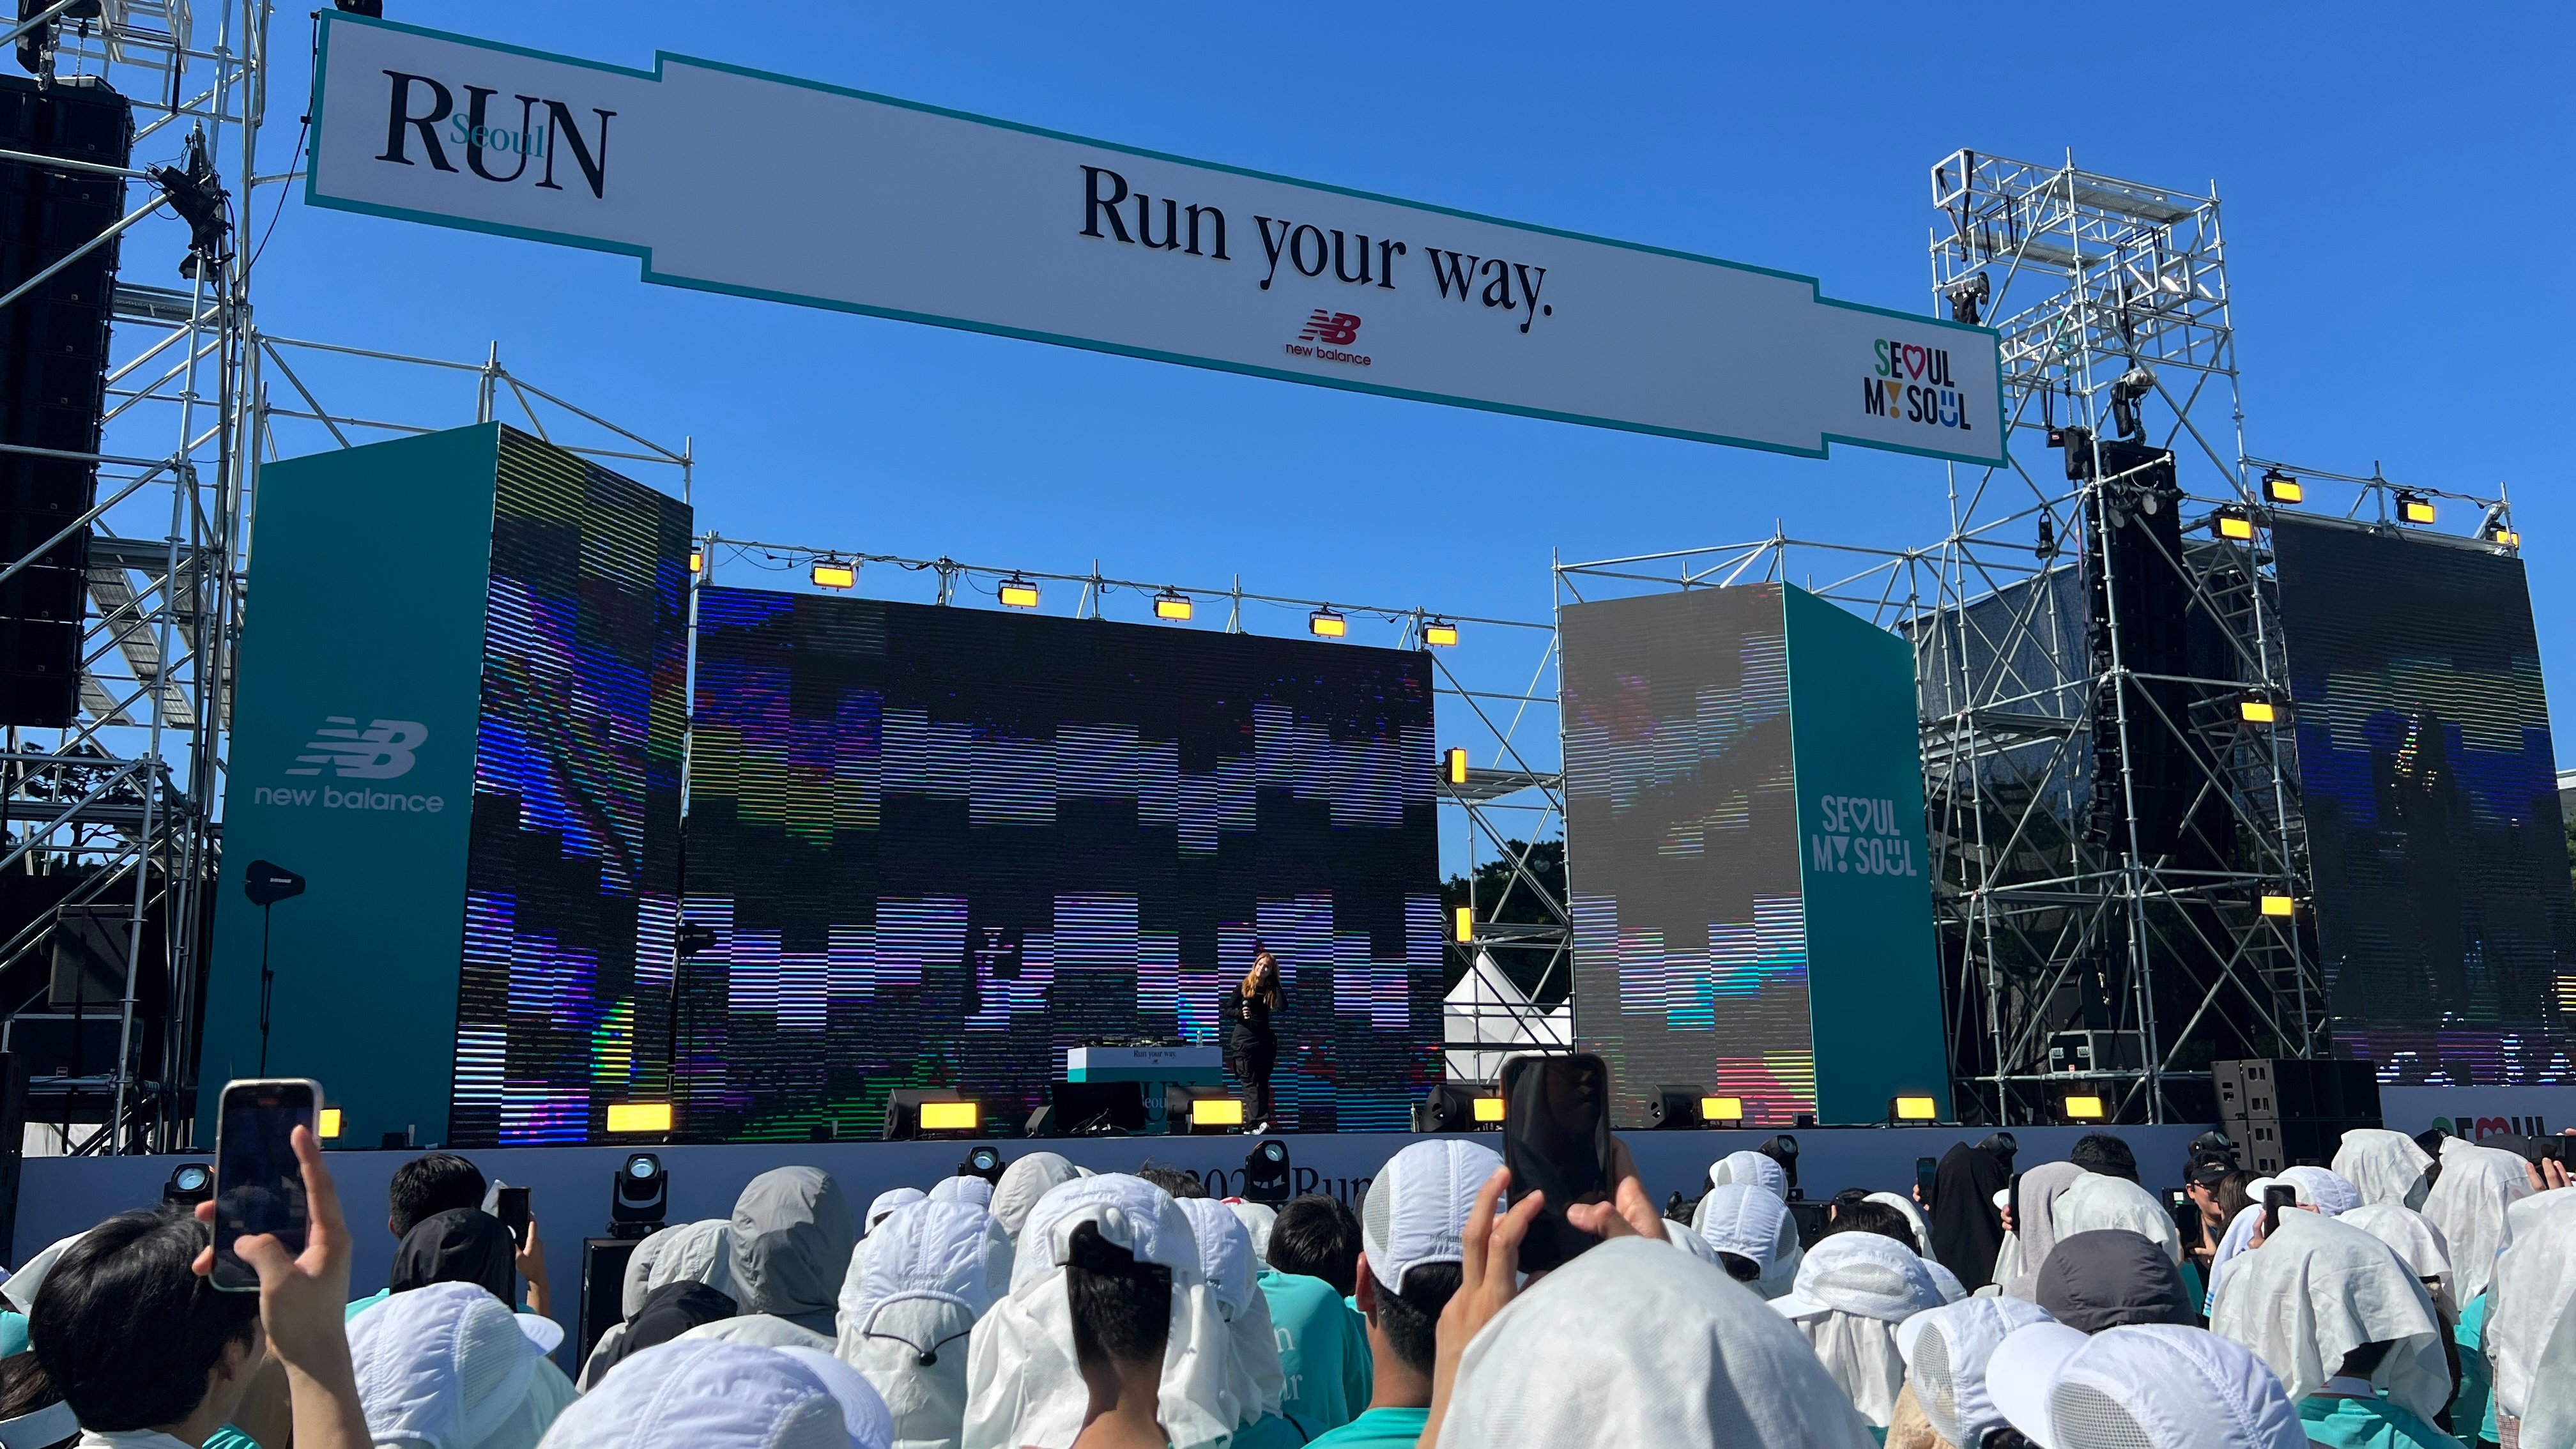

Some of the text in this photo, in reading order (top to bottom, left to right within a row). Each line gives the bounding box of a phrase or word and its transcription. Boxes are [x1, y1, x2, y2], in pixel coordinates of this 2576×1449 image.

[374, 70, 617, 199] RUN
[450, 113, 544, 158] Seoul
[1079, 165, 1553, 334] Run your way.
[1286, 344, 1372, 366] new balance
[255, 785, 445, 813] new balance
[1148, 1051, 1163, 1059] your
[1140, 1093, 1168, 1109] eou
